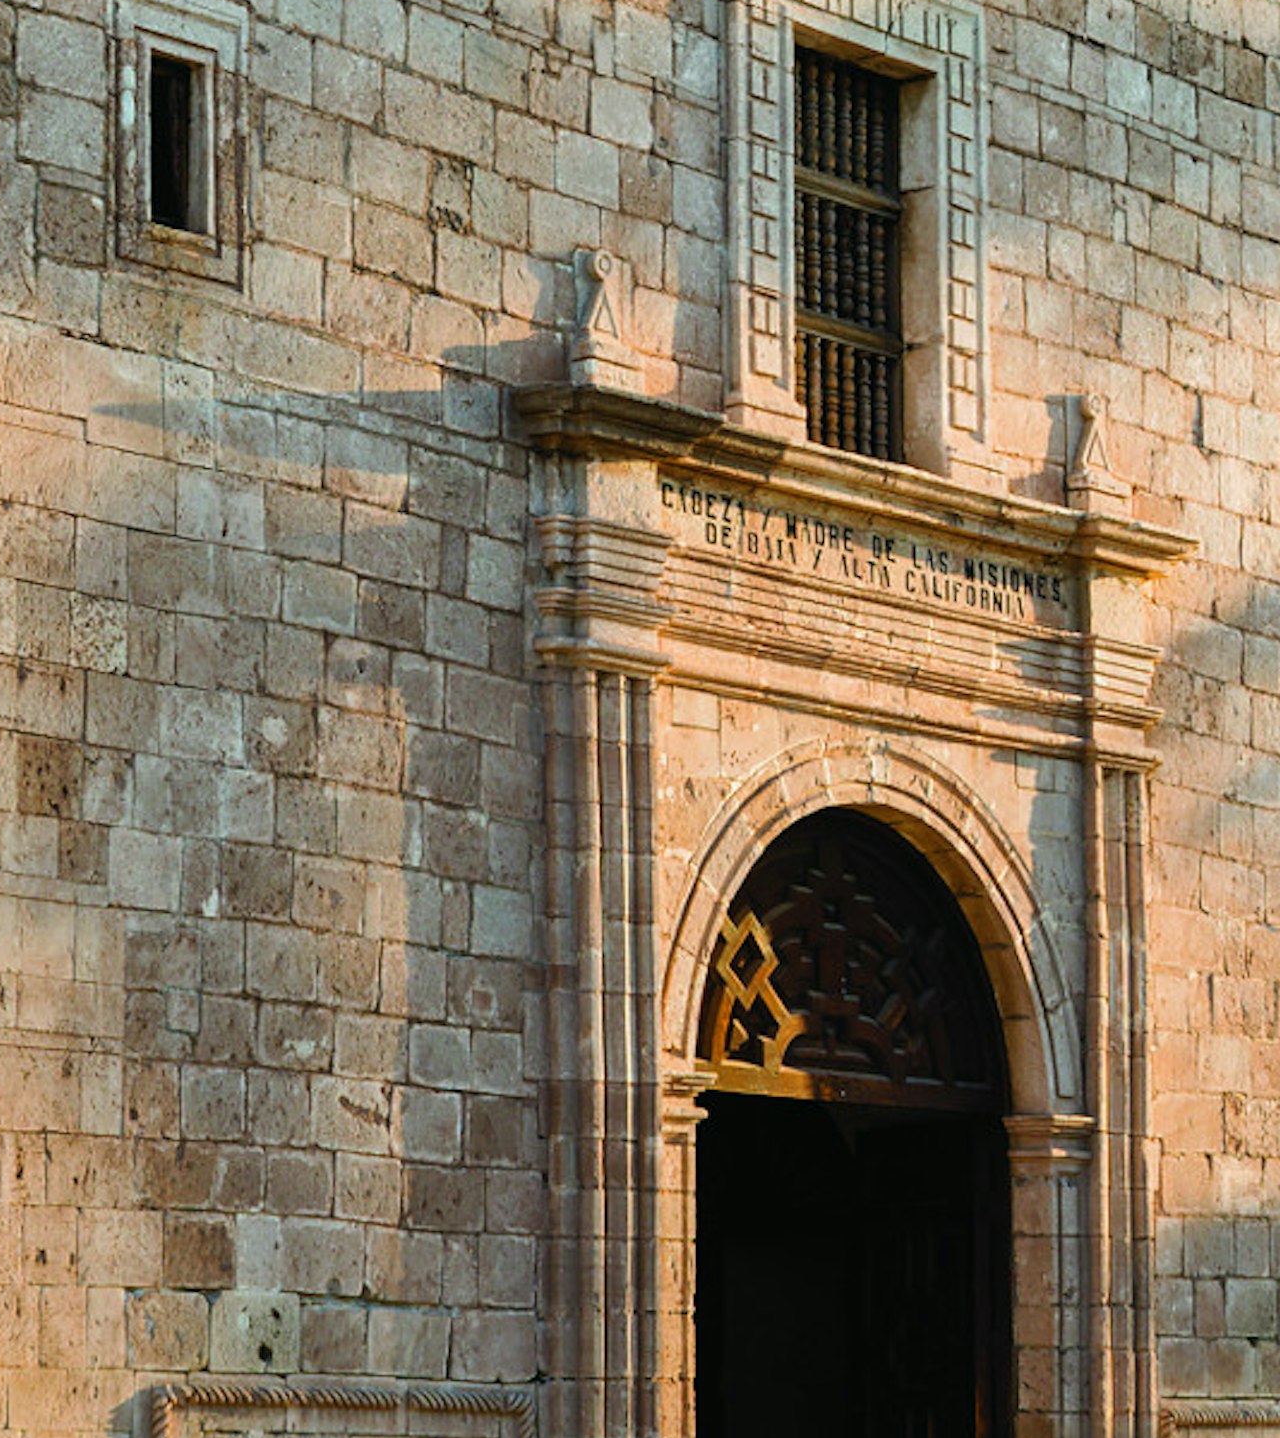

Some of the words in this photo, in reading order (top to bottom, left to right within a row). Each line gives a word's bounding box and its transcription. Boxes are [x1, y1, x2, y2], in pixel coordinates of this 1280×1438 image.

[660, 482, 746, 526] CABEZA
[762, 508, 771, 532] Y
[786, 512, 855, 553] MADRE
[872, 534, 896, 563] DE
[911, 543, 949, 575] LAS
[705, 521, 733, 550] DE
[747, 532, 797, 565] BAJA
[813, 549, 823, 570] Y
[841, 553, 891, 588] ALTA
[907, 570, 1025, 618] CALIFORNIA
